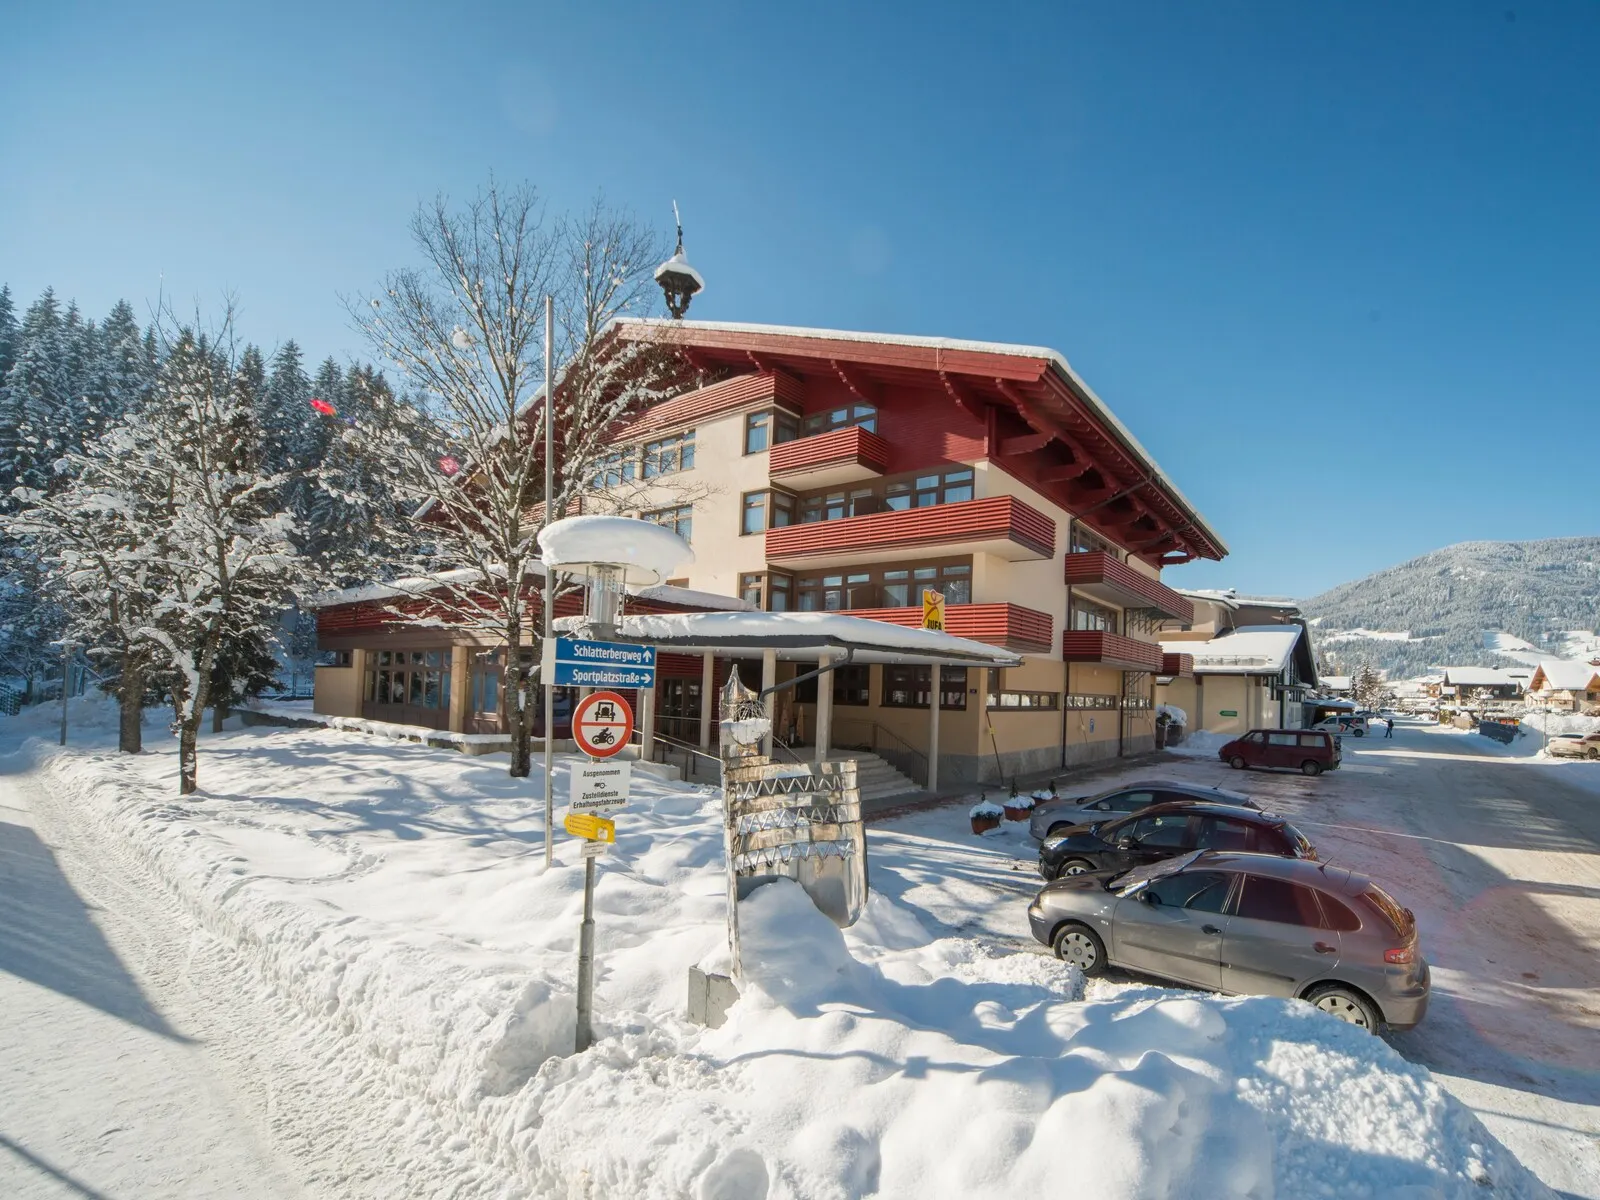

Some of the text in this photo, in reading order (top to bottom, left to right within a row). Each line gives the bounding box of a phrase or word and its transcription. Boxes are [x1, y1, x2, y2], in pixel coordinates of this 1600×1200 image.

[927, 618, 942, 630] JUFA
[573, 644, 642, 663] Schlatterbergweg
[572, 669, 640, 684] Sportplatzstraße
[582, 769, 621, 778] Ausgenommen
[582, 790, 619, 800] Zustelldienste
[573, 798, 626, 809] Erhaltungsfahrzeuge
